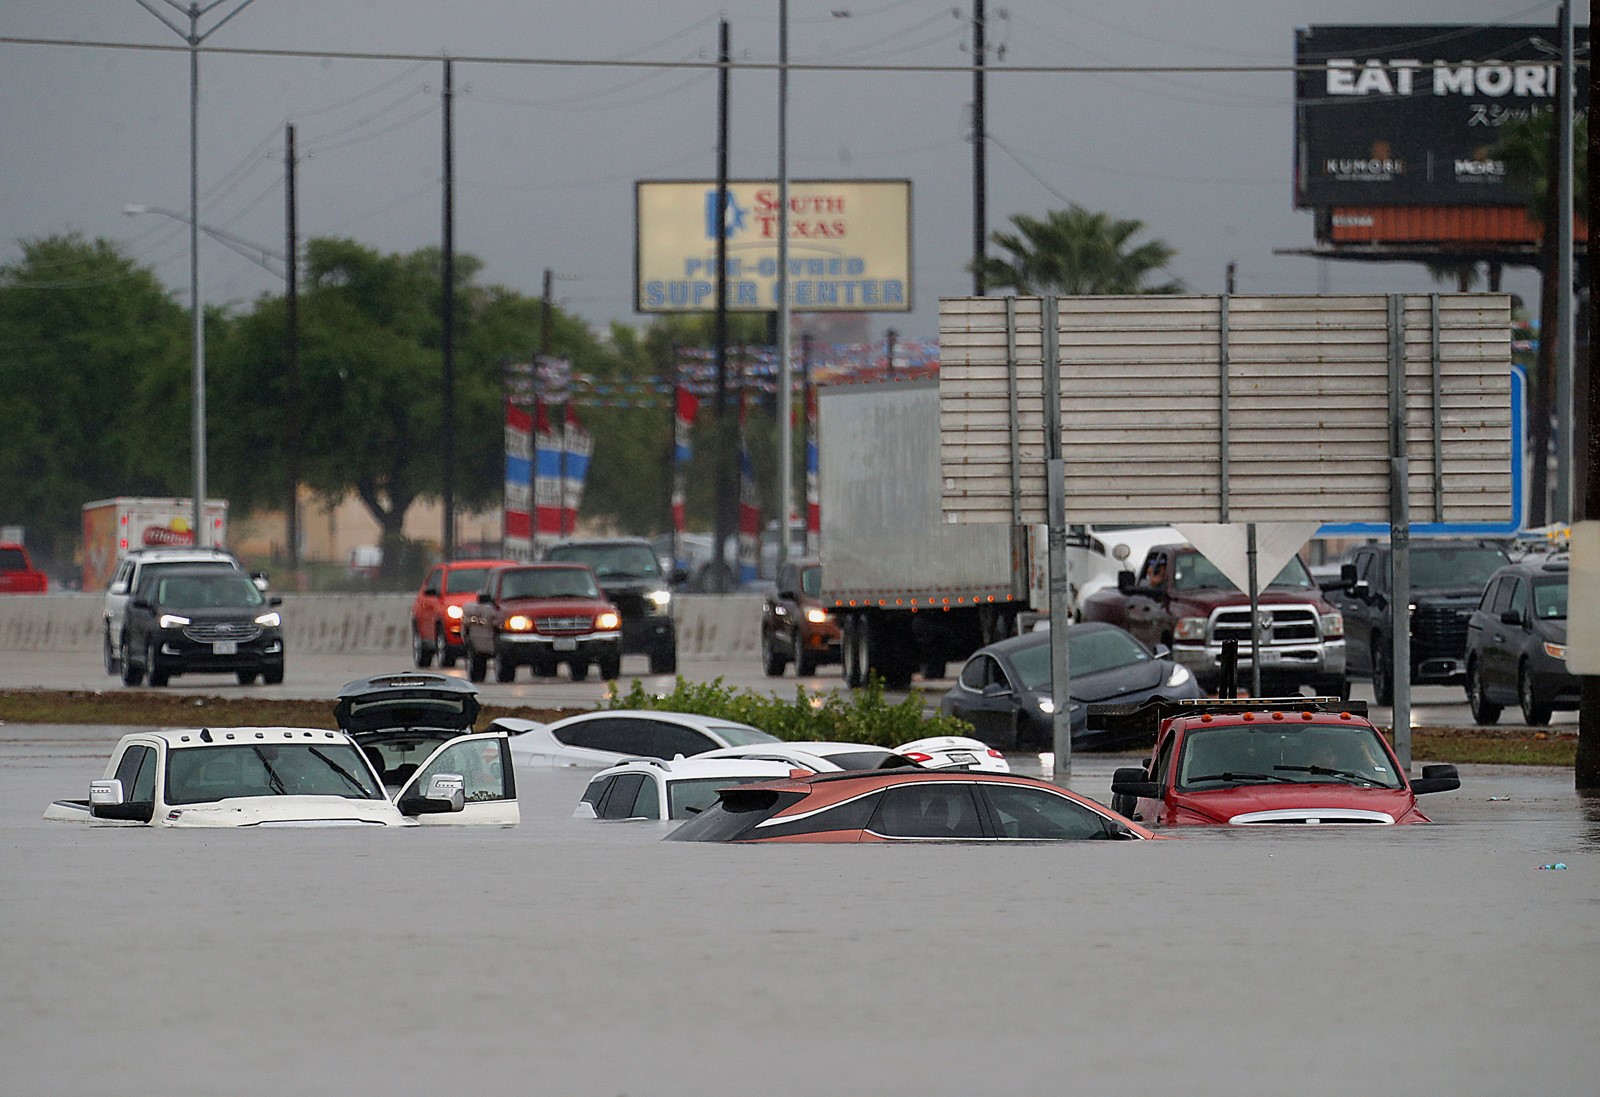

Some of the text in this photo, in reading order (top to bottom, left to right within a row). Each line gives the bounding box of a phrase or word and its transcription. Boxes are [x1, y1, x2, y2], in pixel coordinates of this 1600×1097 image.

[1326, 58, 1422, 95] EAT
[1327, 158, 1403, 174] KUMORI
[754, 216, 846, 238] TXAS
